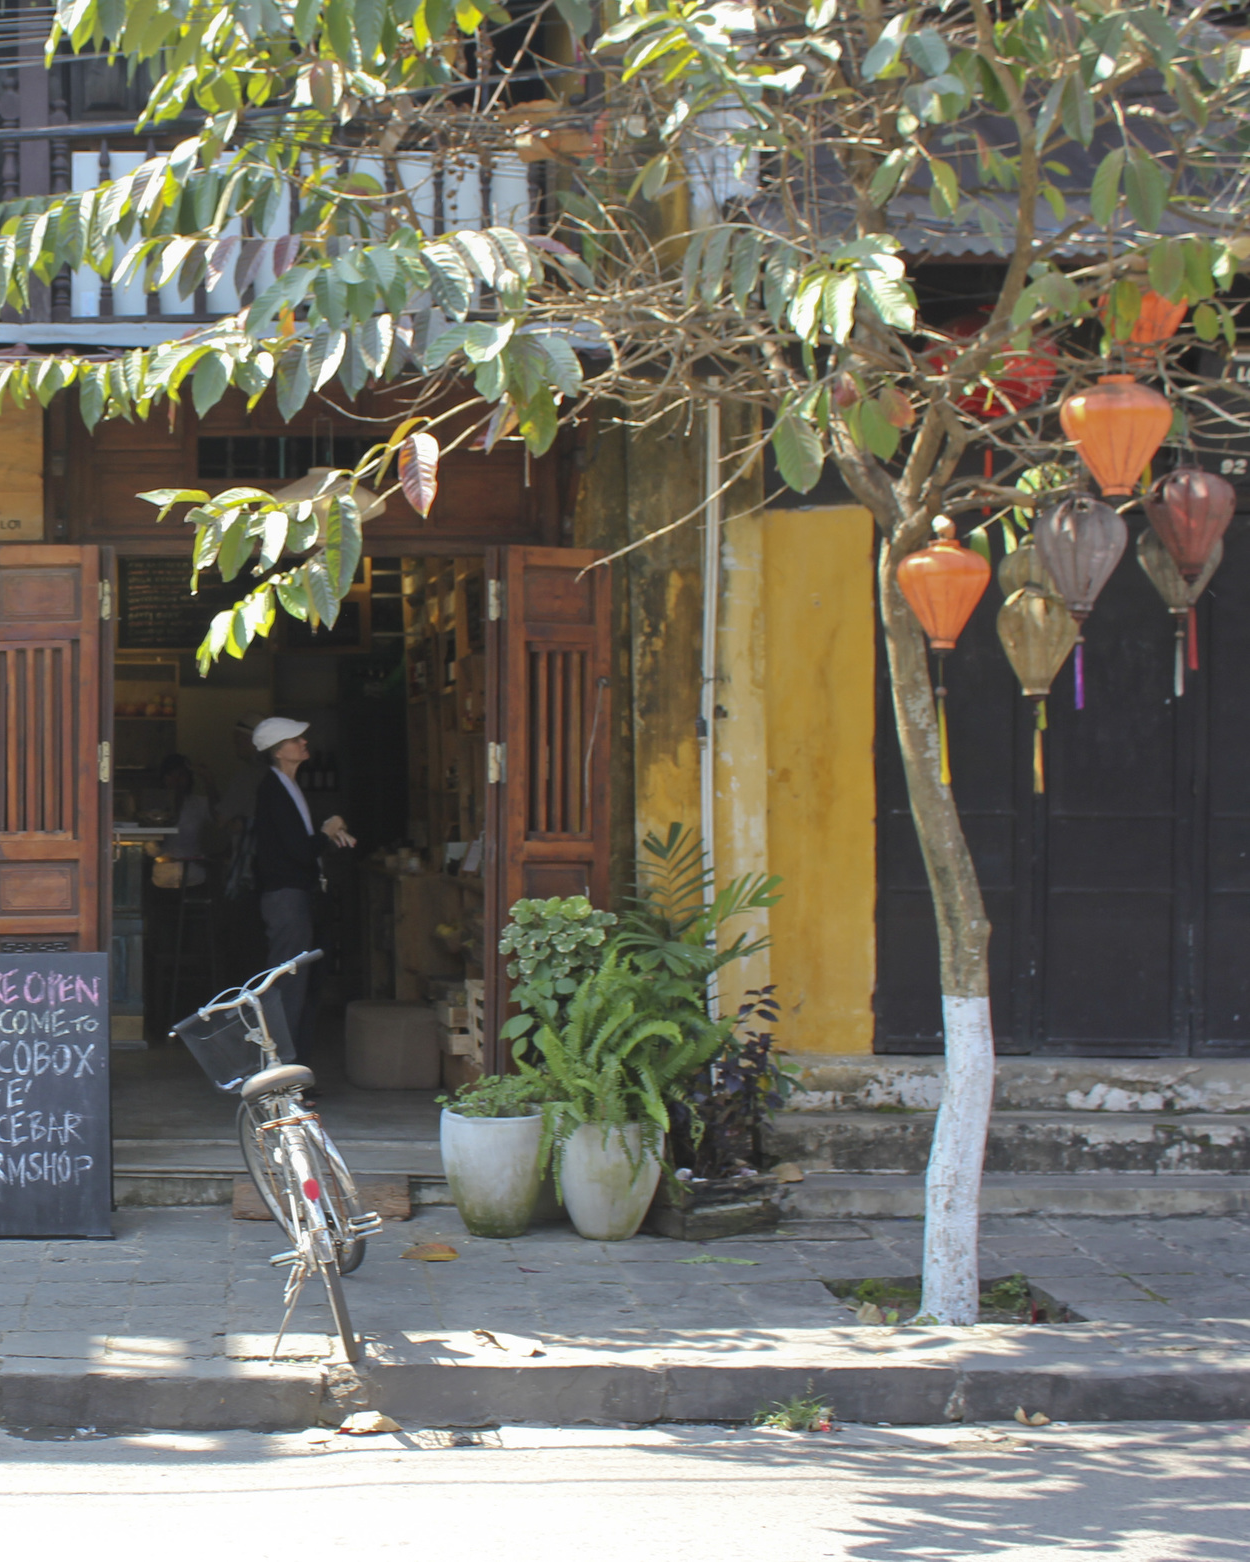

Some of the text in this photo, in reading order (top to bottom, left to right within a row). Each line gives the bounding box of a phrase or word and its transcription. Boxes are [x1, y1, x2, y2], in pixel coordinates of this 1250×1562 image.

[1220, 458, 1248, 475] 92
[23, 971, 101, 1006] OPEN
[70, 1014, 99, 1034] TO
